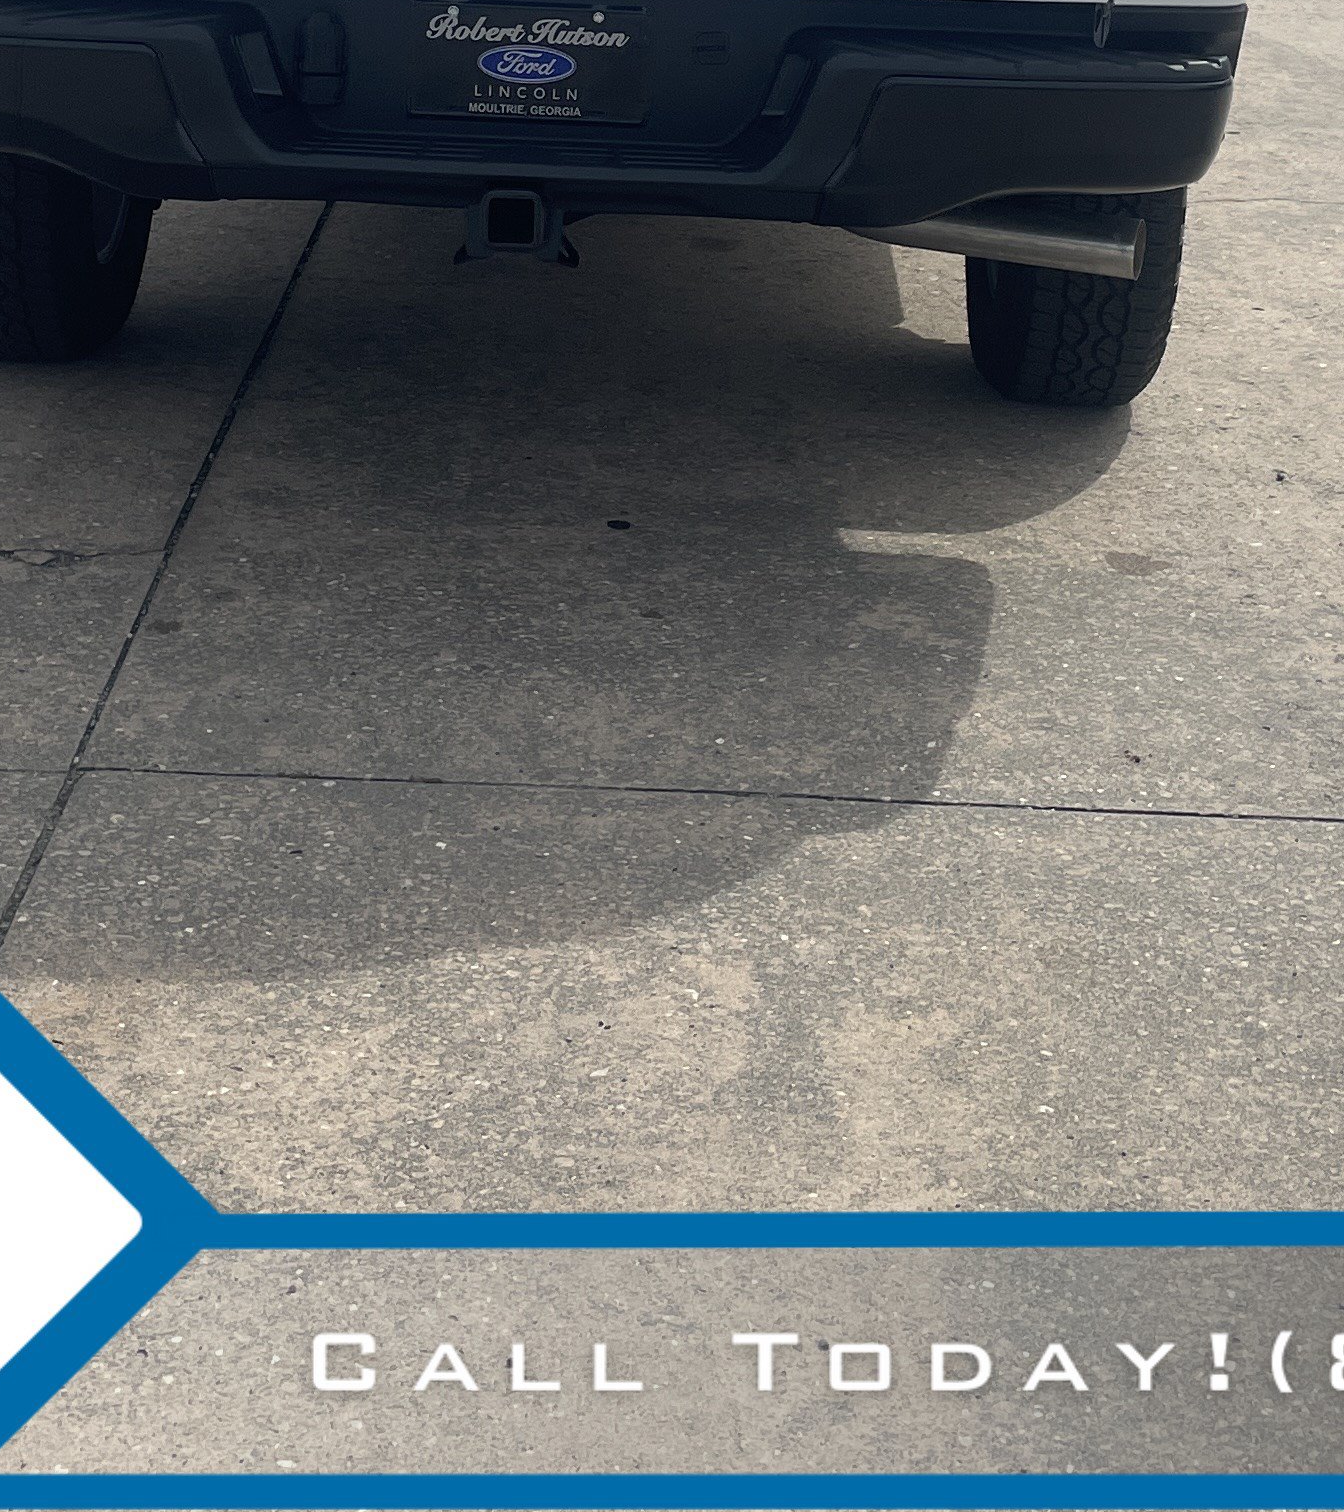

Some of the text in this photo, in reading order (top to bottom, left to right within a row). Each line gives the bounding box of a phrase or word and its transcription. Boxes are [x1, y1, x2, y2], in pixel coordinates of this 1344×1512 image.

[425, 12, 630, 48] Robert Hutson
[497, 50, 557, 76] Ford
[474, 84, 578, 101] LINCOLN
[468, 102, 581, 117] MOULTRIE, GEORGIA
